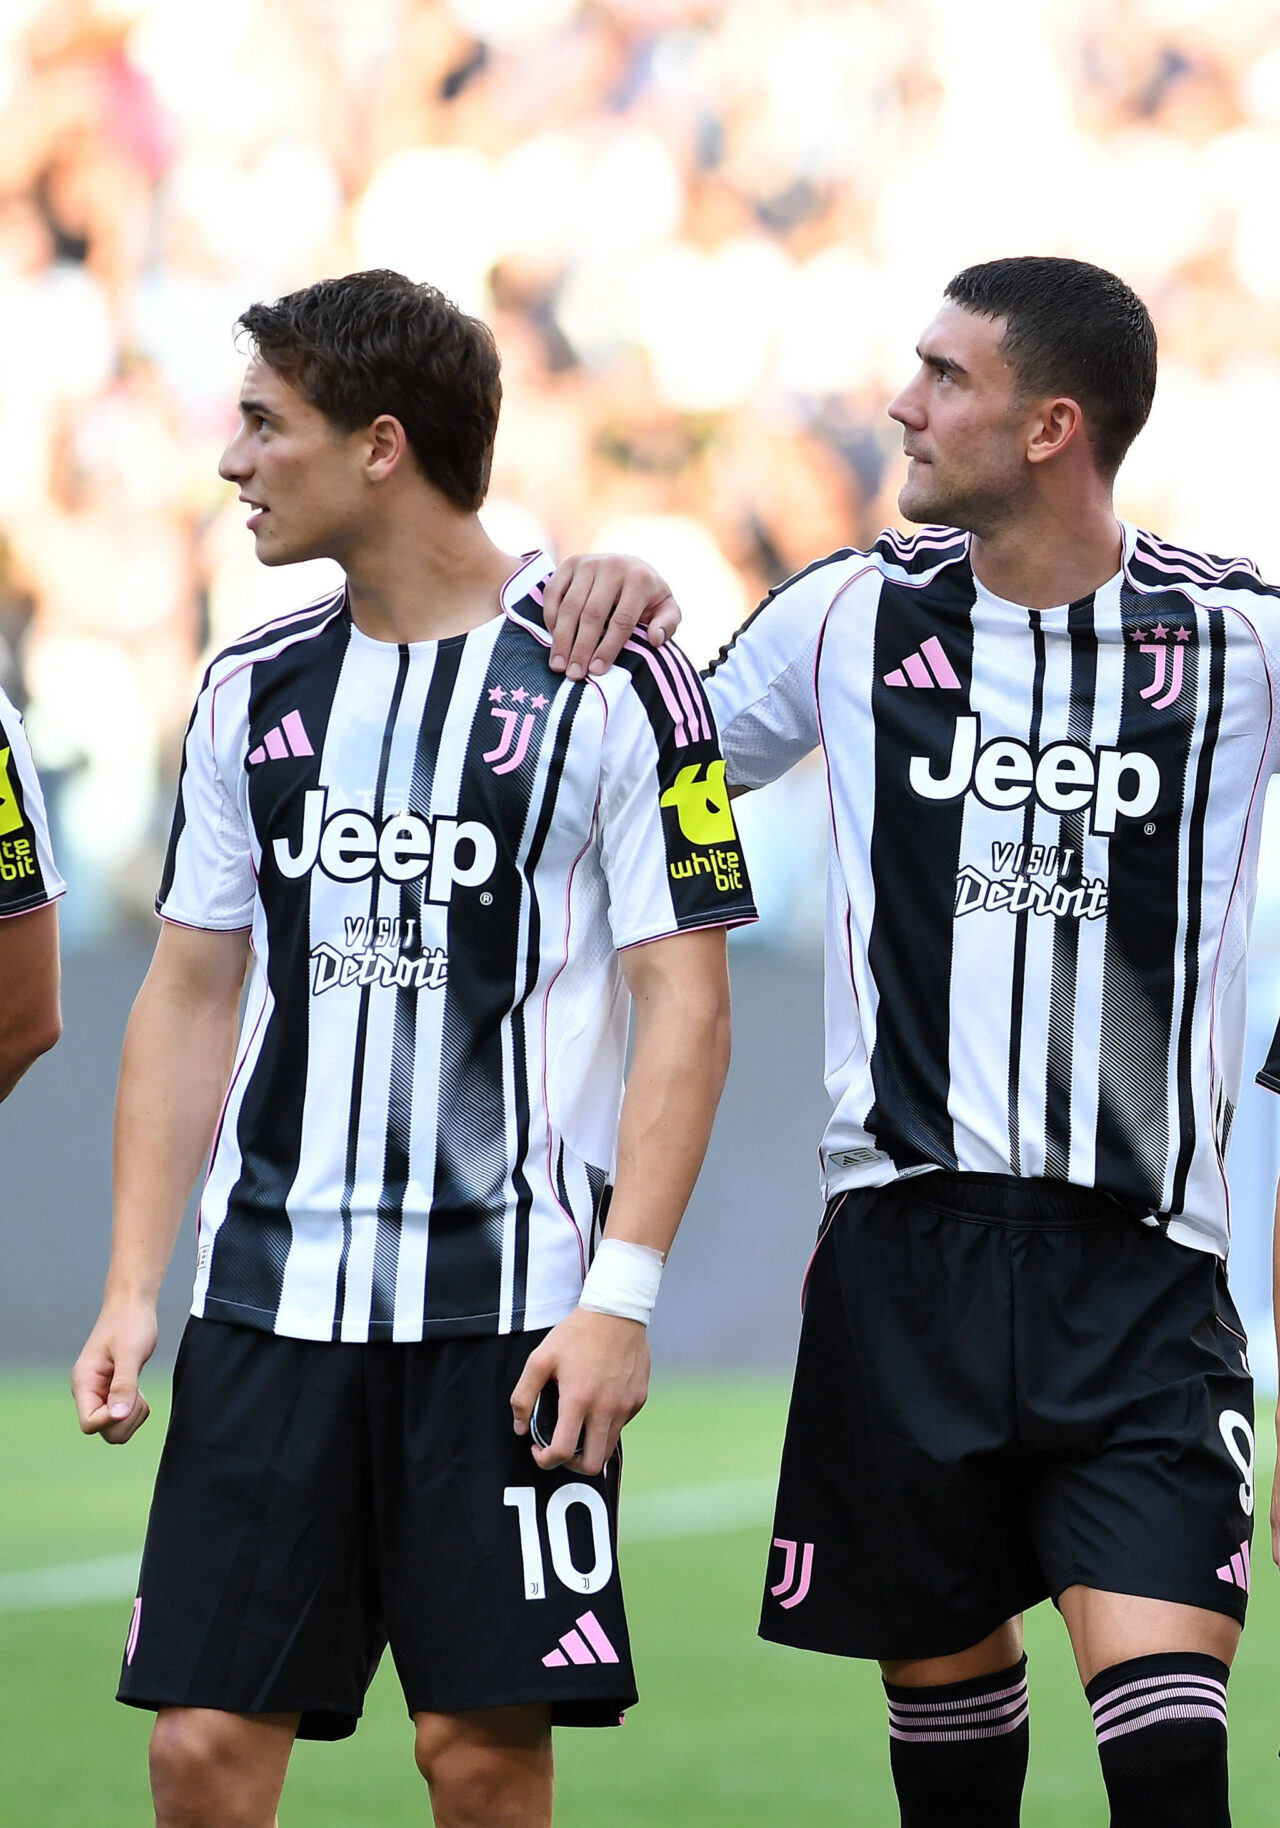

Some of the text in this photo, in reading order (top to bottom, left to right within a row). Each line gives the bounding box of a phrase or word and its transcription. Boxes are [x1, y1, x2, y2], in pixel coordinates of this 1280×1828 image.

[908, 715, 1161, 833] Jeep
[272, 789, 498, 903] Jeep
[670, 848, 739, 880] white
[992, 841, 1075, 877] VISIT
[715, 867, 743, 892] bit
[954, 865, 1108, 920] Detroit
[345, 917, 416, 948] VISIT
[311, 942, 448, 996] Detroit
[1218, 1409, 1254, 1517] 9
[503, 1482, 613, 1600] 10
